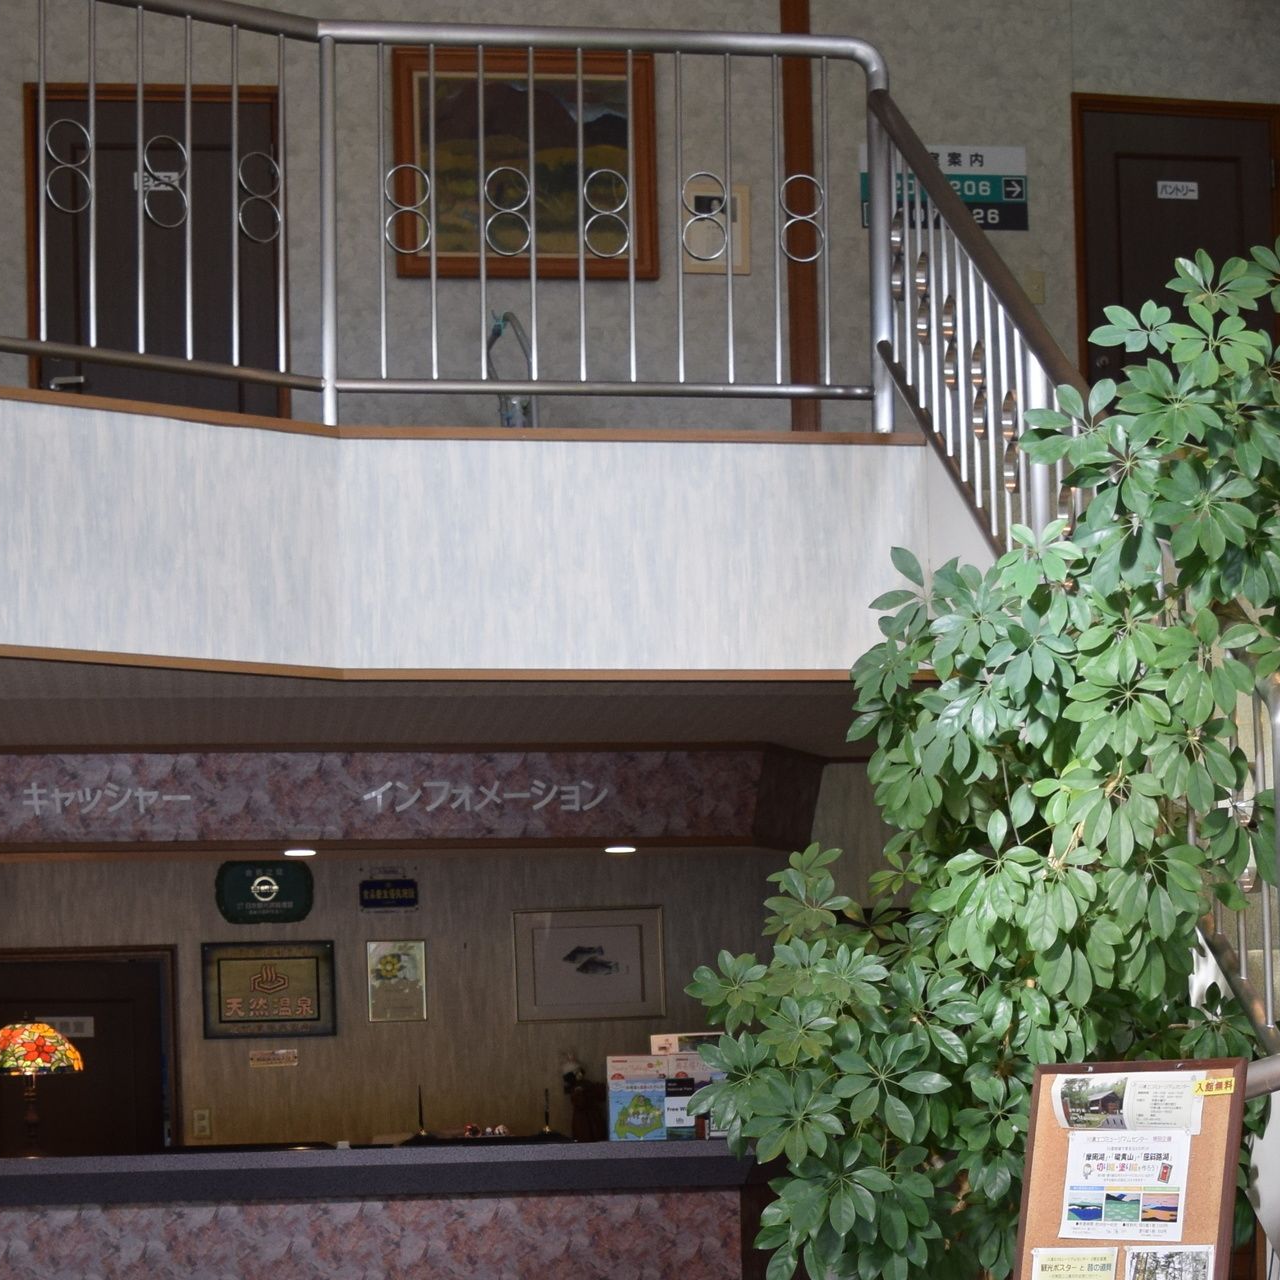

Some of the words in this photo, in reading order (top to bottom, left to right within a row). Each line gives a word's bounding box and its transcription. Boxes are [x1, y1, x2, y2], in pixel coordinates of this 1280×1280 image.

[949, 180, 991, 196] 206
[1160, 184, 1196, 196] パントリー
[973, 208, 1000, 224] 26
[21, 781, 192, 816] キャッシャー
[363, 780, 610, 813] インフォメーション
[225, 996, 314, 1017] 天然温泉
[1195, 1080, 1233, 1093] 入館無料
[1040, 1263, 1076, 1272] 観光ポスター
